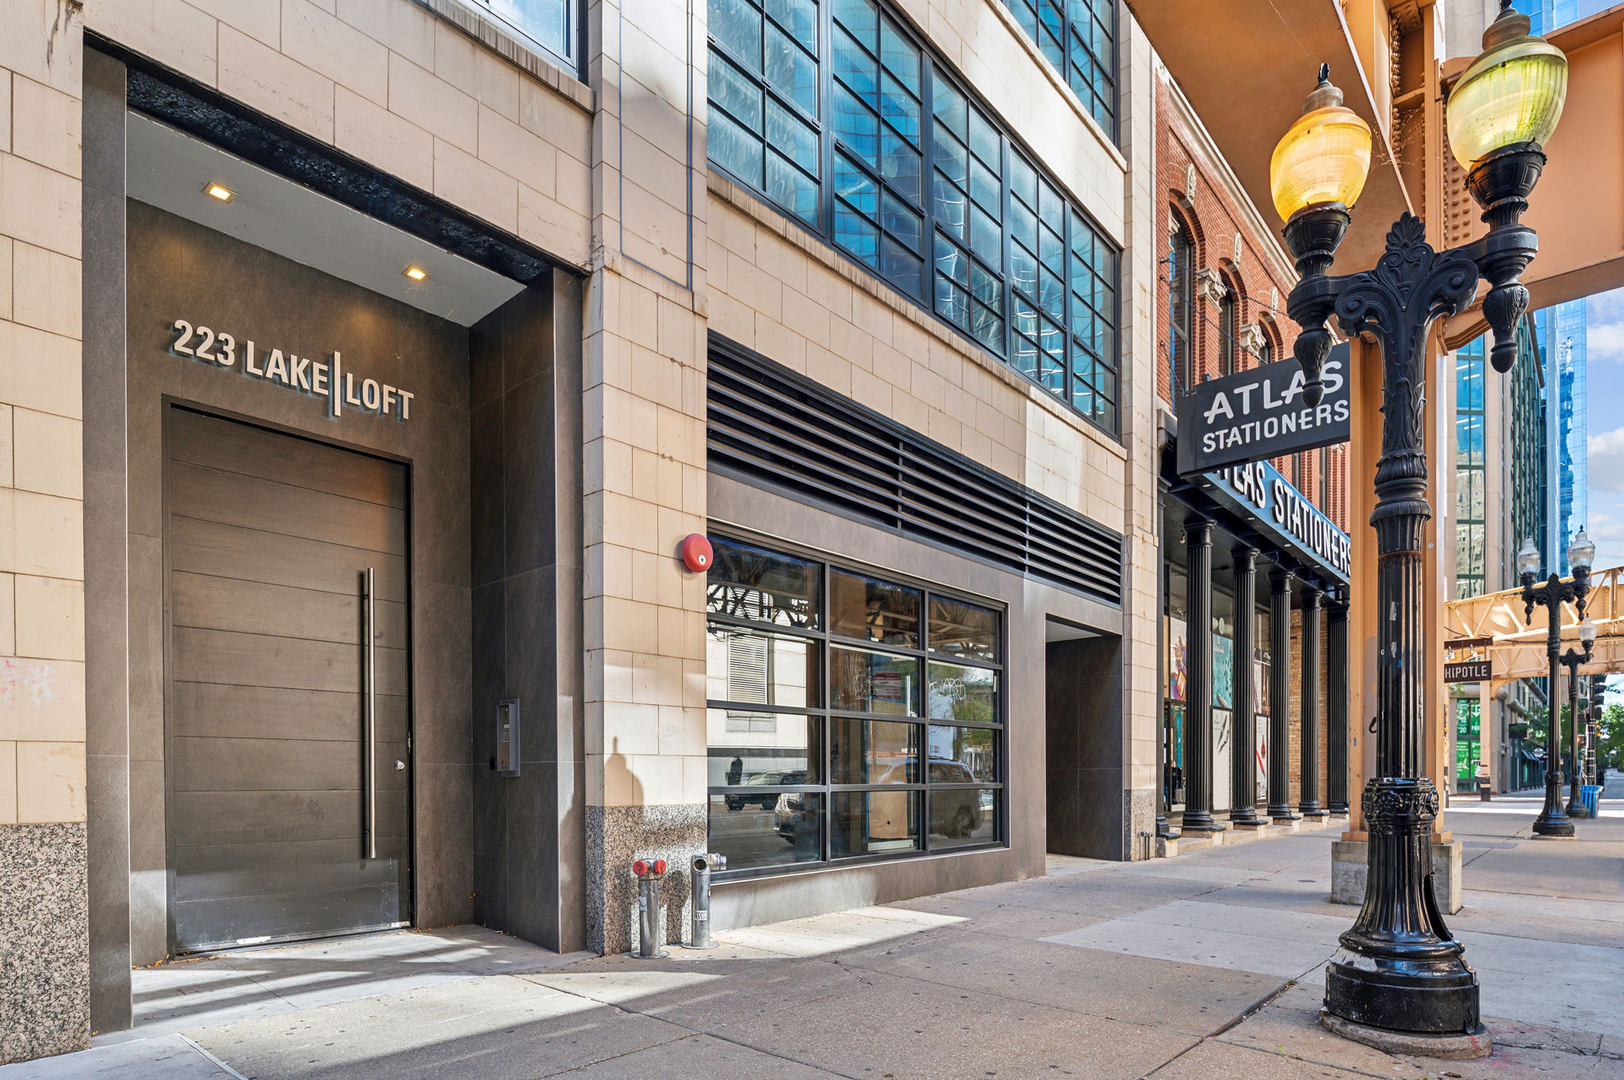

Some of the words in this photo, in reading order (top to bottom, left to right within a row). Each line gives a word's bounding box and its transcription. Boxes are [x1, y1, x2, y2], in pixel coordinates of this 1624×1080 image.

[173, 319, 235, 366] 223
[246, 340, 329, 395] LAKE
[346, 372, 414, 420] LOFT
[1203, 361, 1344, 425] ATLAS
[1203, 399, 1349, 453] STATIONERS
[1218, 461, 1266, 508] LAS
